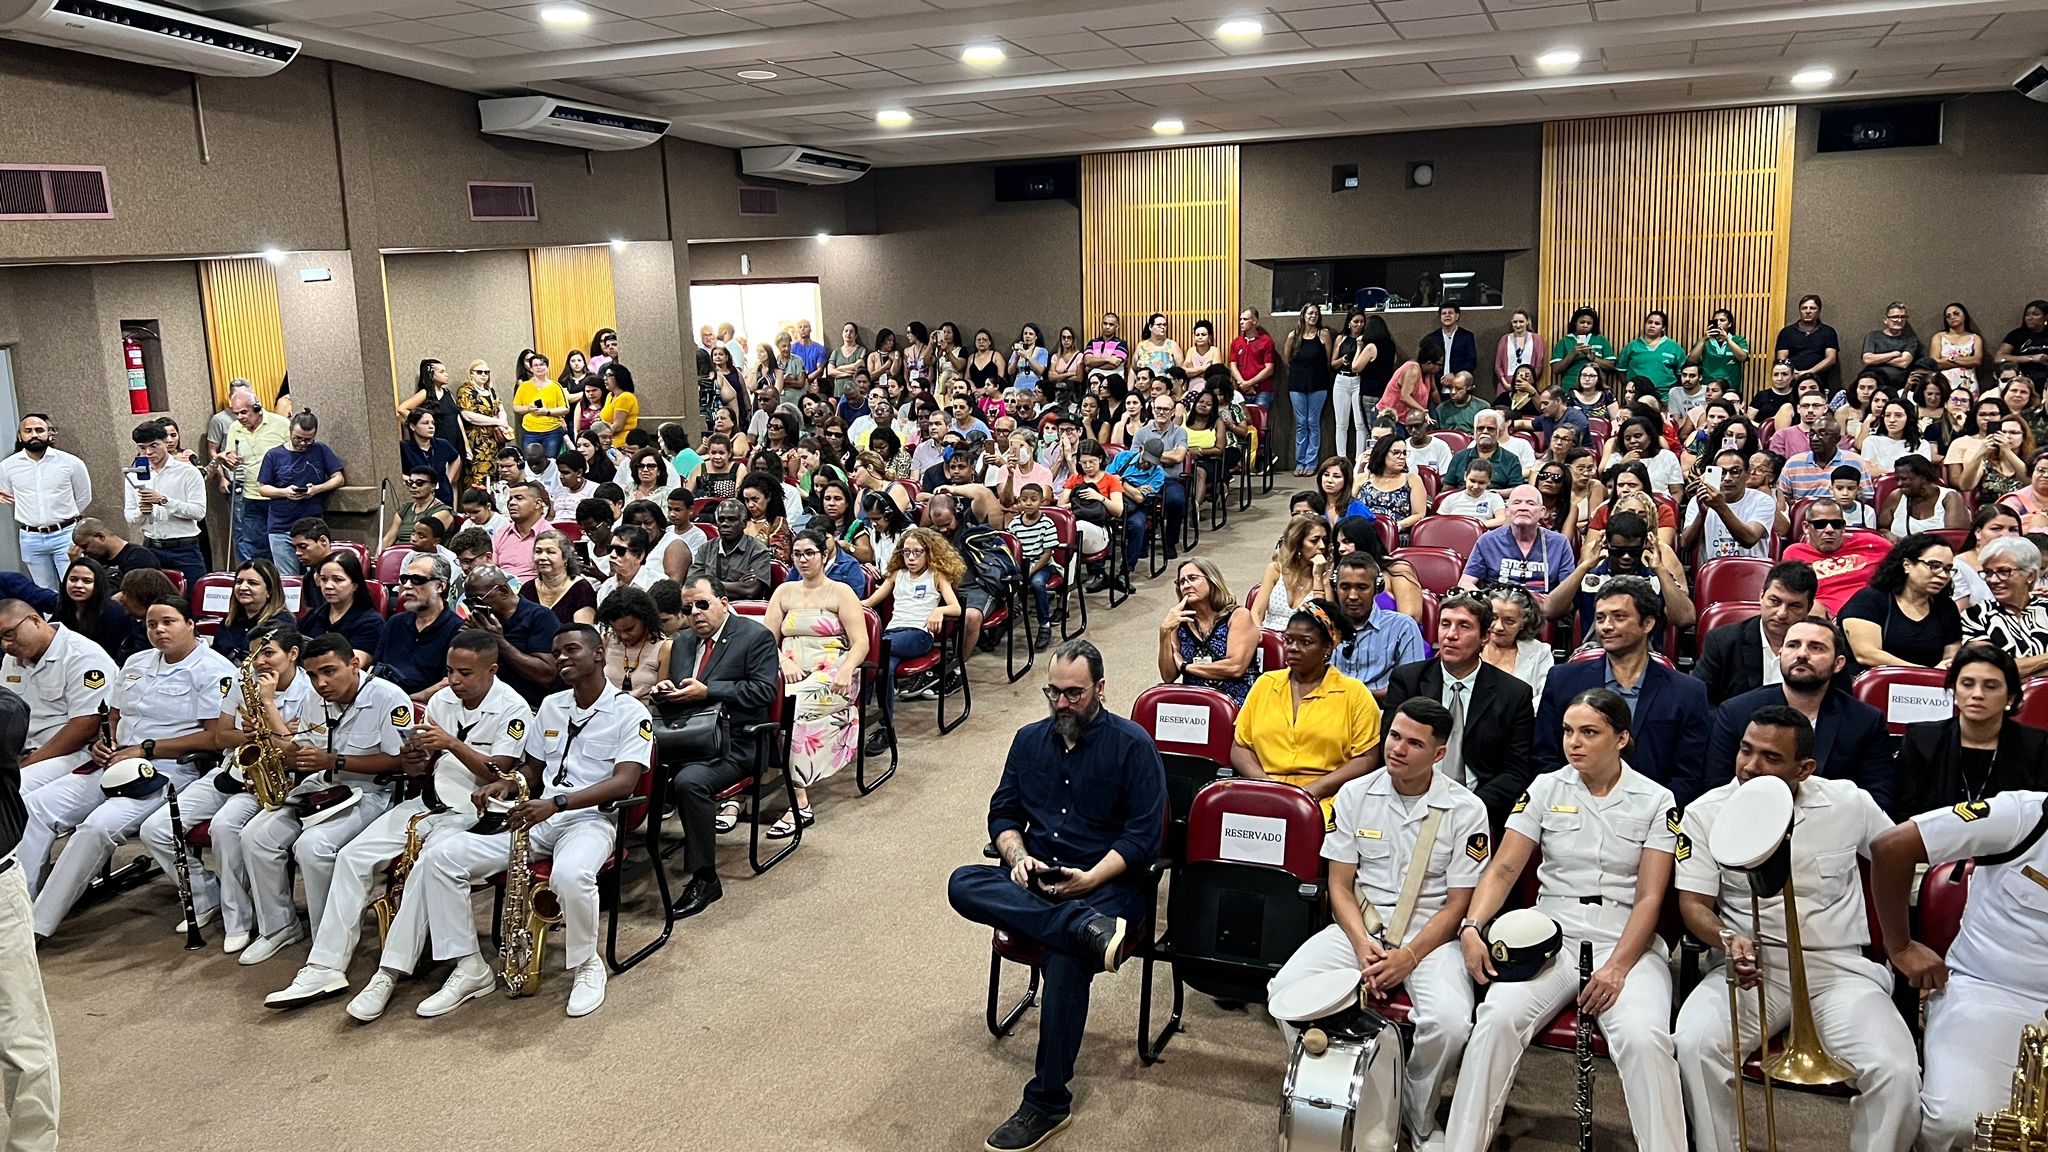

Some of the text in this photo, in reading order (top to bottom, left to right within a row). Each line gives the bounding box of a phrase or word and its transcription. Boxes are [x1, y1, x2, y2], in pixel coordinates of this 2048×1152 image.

[1892, 695, 1950, 707] RESERVADO
[1159, 715, 1207, 726] RESERVADO
[1225, 828, 1282, 843] RESERVADO
